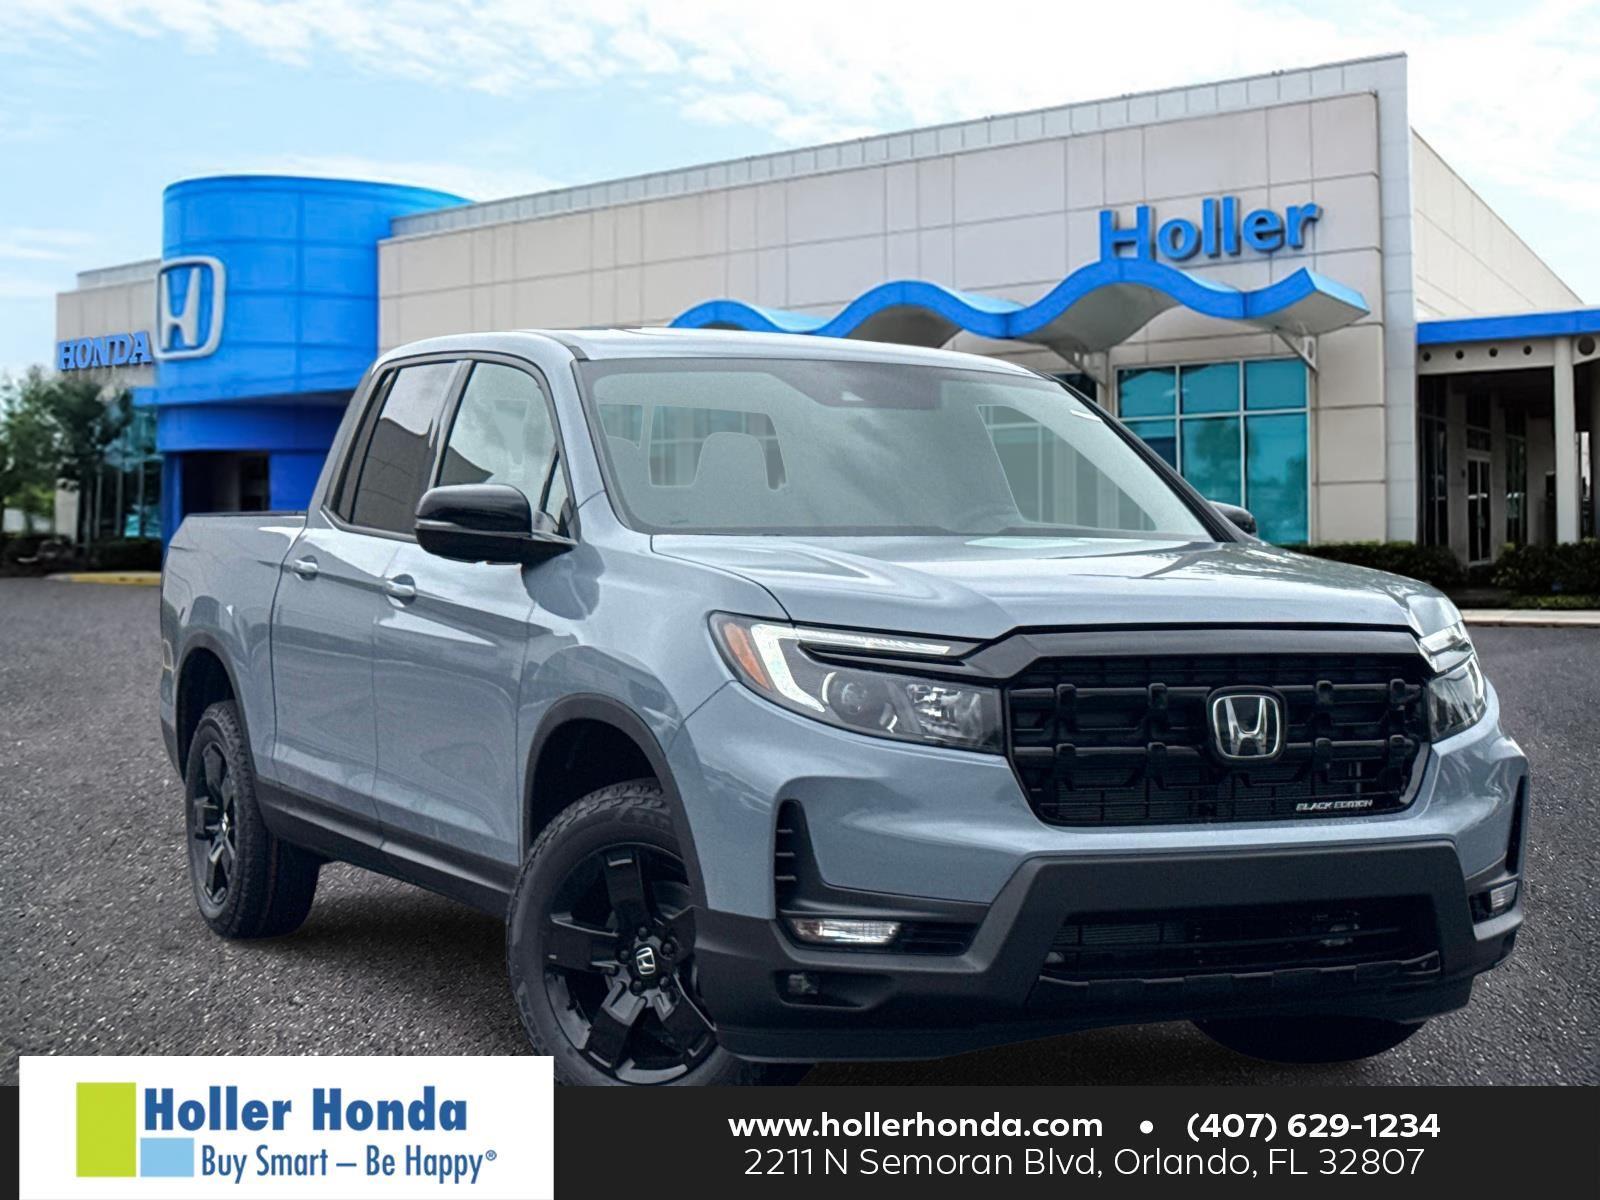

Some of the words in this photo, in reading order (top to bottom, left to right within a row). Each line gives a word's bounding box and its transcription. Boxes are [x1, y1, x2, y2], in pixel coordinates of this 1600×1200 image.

[1099, 196, 1321, 262] Holler
[58, 331, 152, 370] HONDA
[1296, 802, 1332, 811] BLACK
